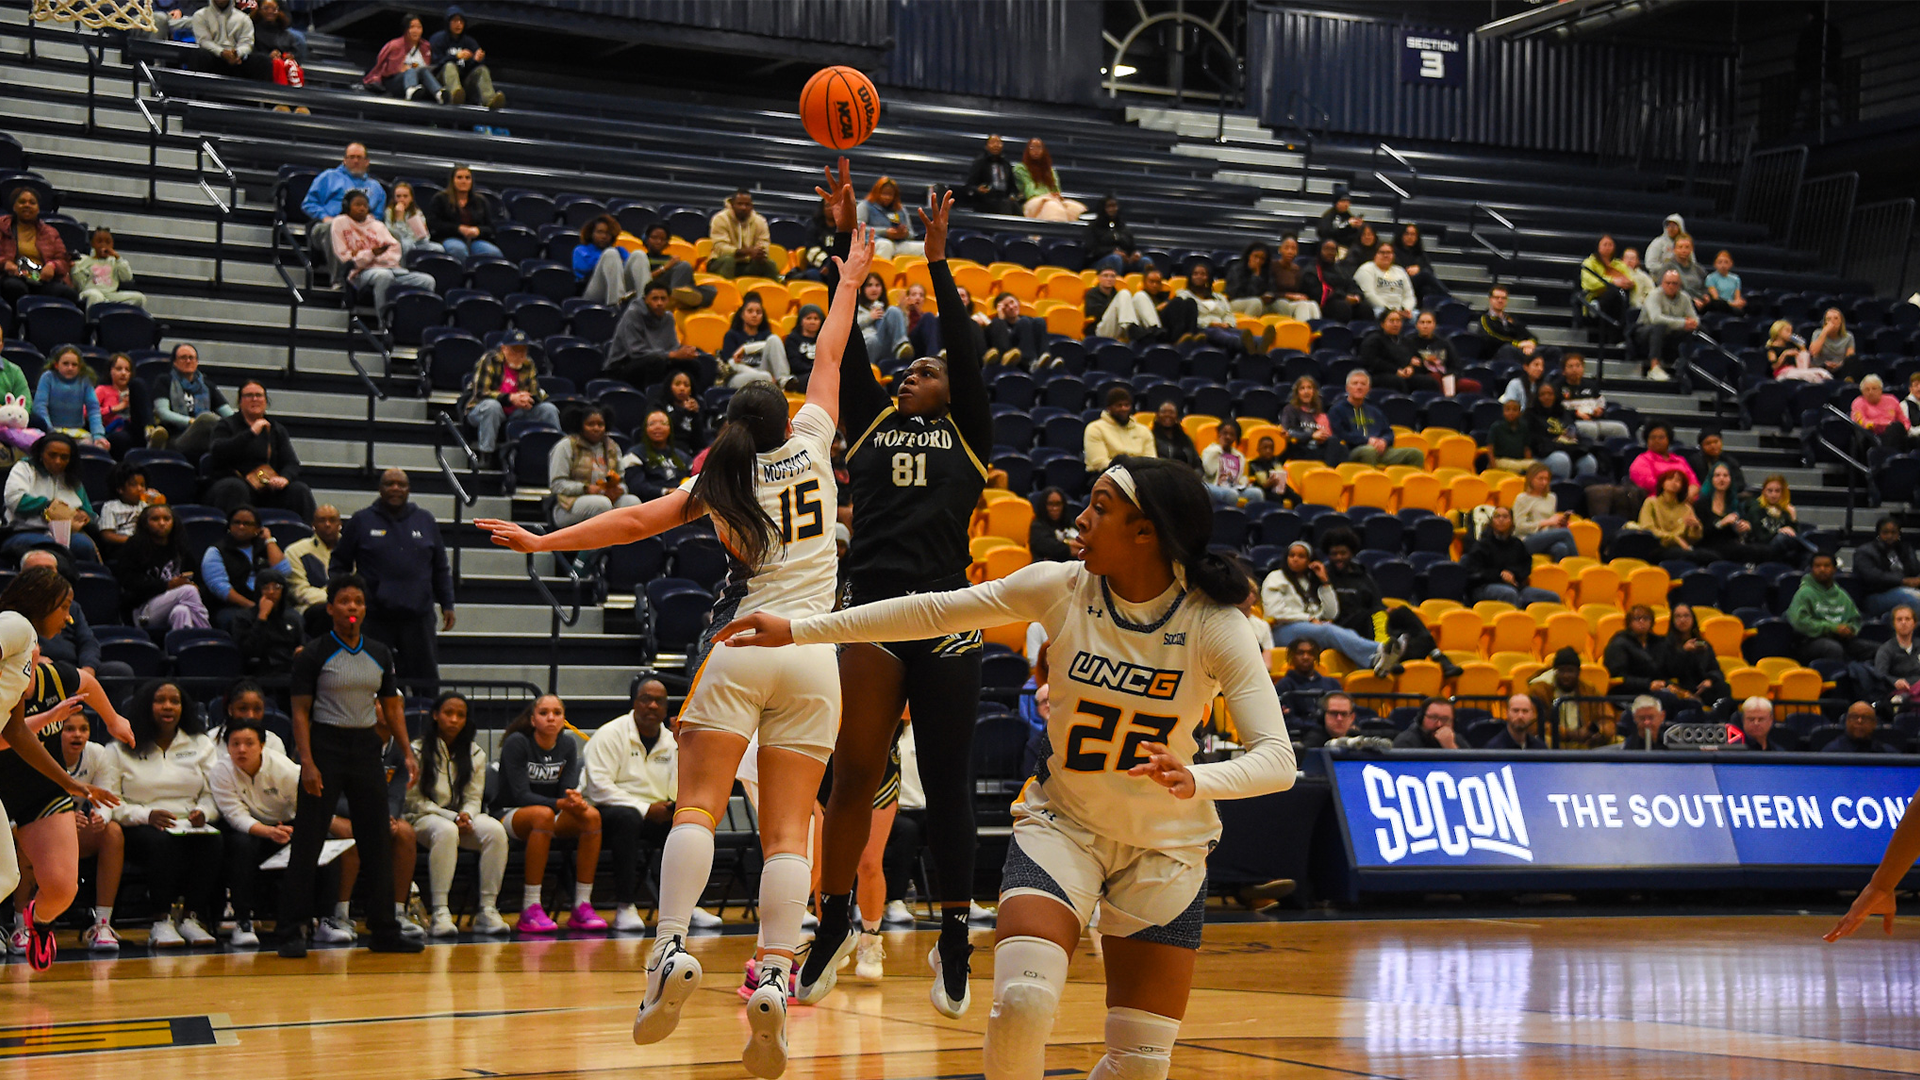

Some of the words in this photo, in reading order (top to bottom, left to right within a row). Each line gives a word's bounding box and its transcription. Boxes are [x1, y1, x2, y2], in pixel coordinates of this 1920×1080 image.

[1406, 36, 1459, 52] SECTION
[1420, 50, 1445, 78] 3
[837, 101, 854, 139] NCAA
[763, 449, 812, 483] MOFFITT
[891, 452, 928, 487] 81
[777, 477, 824, 546] 15
[1068, 651, 1184, 700] UNCG
[1062, 697, 1181, 774] 22
[1547, 794, 1623, 828] THE
[1628, 794, 1823, 829] SOUTHERN
[1831, 796, 1914, 830] CON
